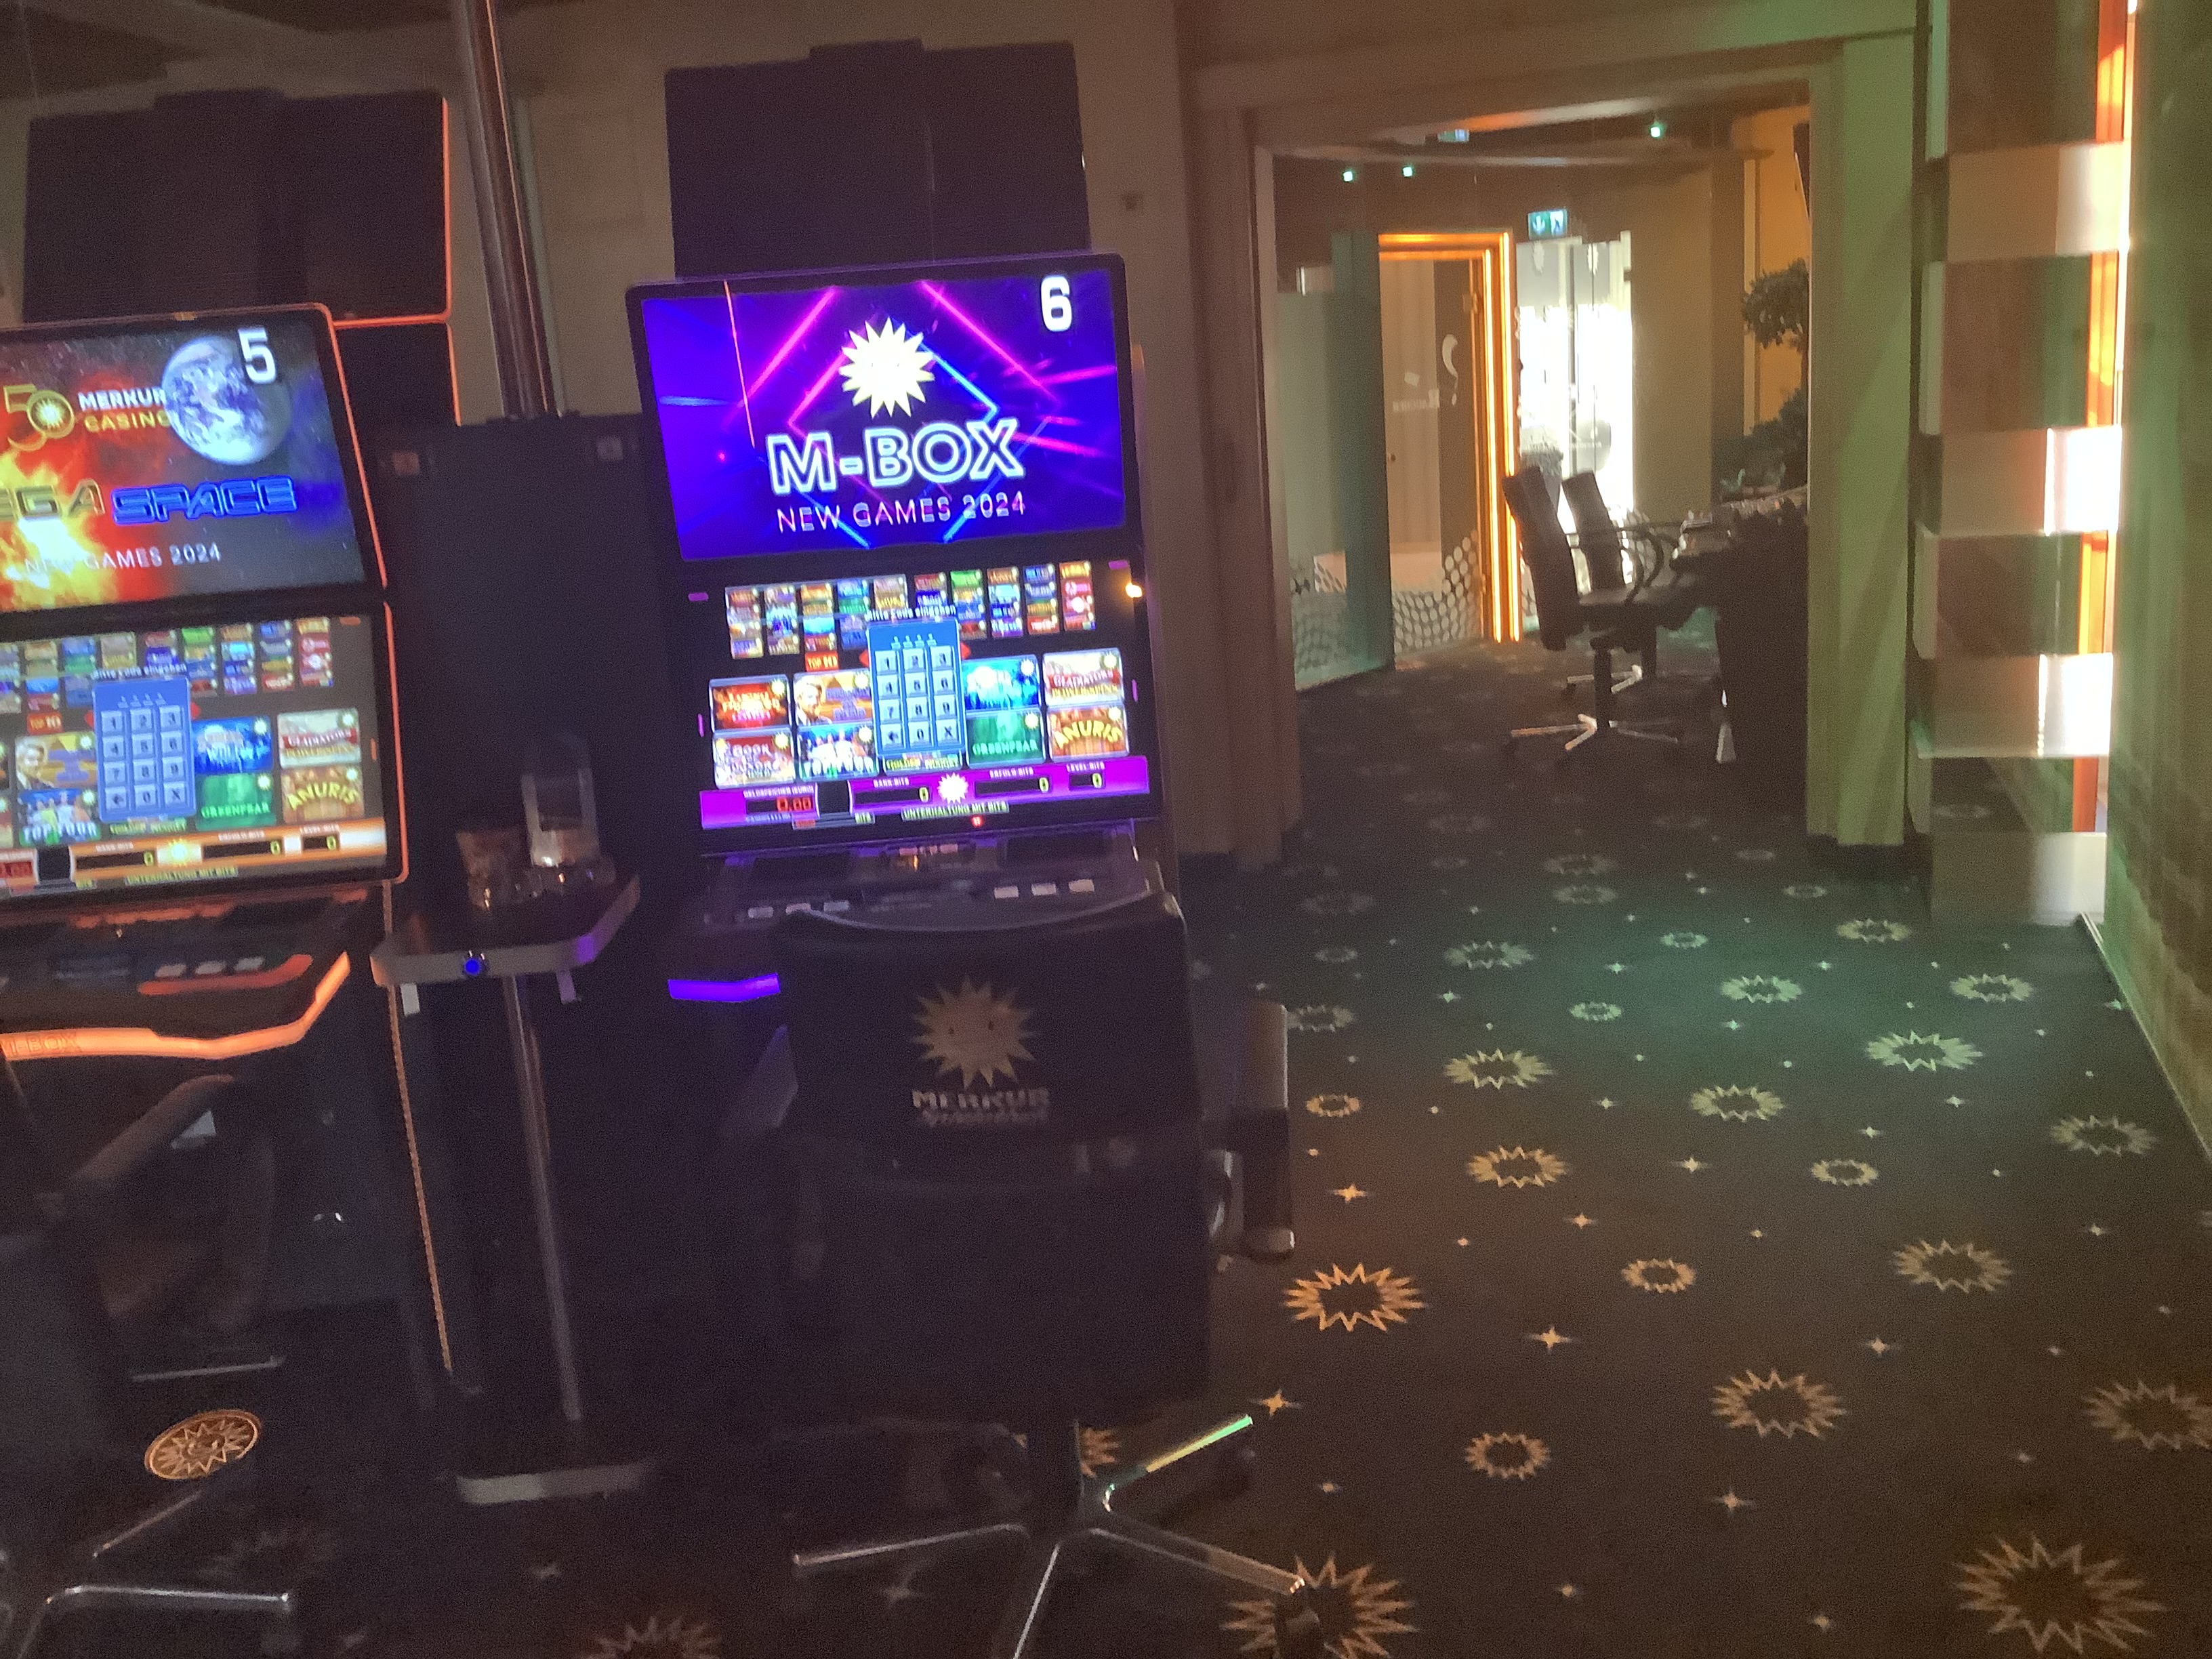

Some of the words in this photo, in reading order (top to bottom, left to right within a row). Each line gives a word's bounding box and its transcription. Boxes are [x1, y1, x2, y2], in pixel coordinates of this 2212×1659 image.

[1040, 275, 1073, 332] 6
[238, 326, 277, 385] 5
[78, 387, 167, 411] MERKUR
[84, 409, 171, 433] CASINO
[766, 417, 1025, 496] M-BOX
[110, 474, 299, 526] SPACE
[776, 504, 842, 533] NEW
[852, 496, 951, 529] GAMES
[963, 491, 1025, 520] 2024
[83, 546, 163, 571] GAMES
[169, 541, 221, 567] 2024
[1052, 719, 1124, 750] ANURIS
[919, 787, 929, 803] 0
[1039, 777, 1049, 793] 0
[1092, 773, 1103, 788] 0
[287, 781, 359, 811] ANURIS
